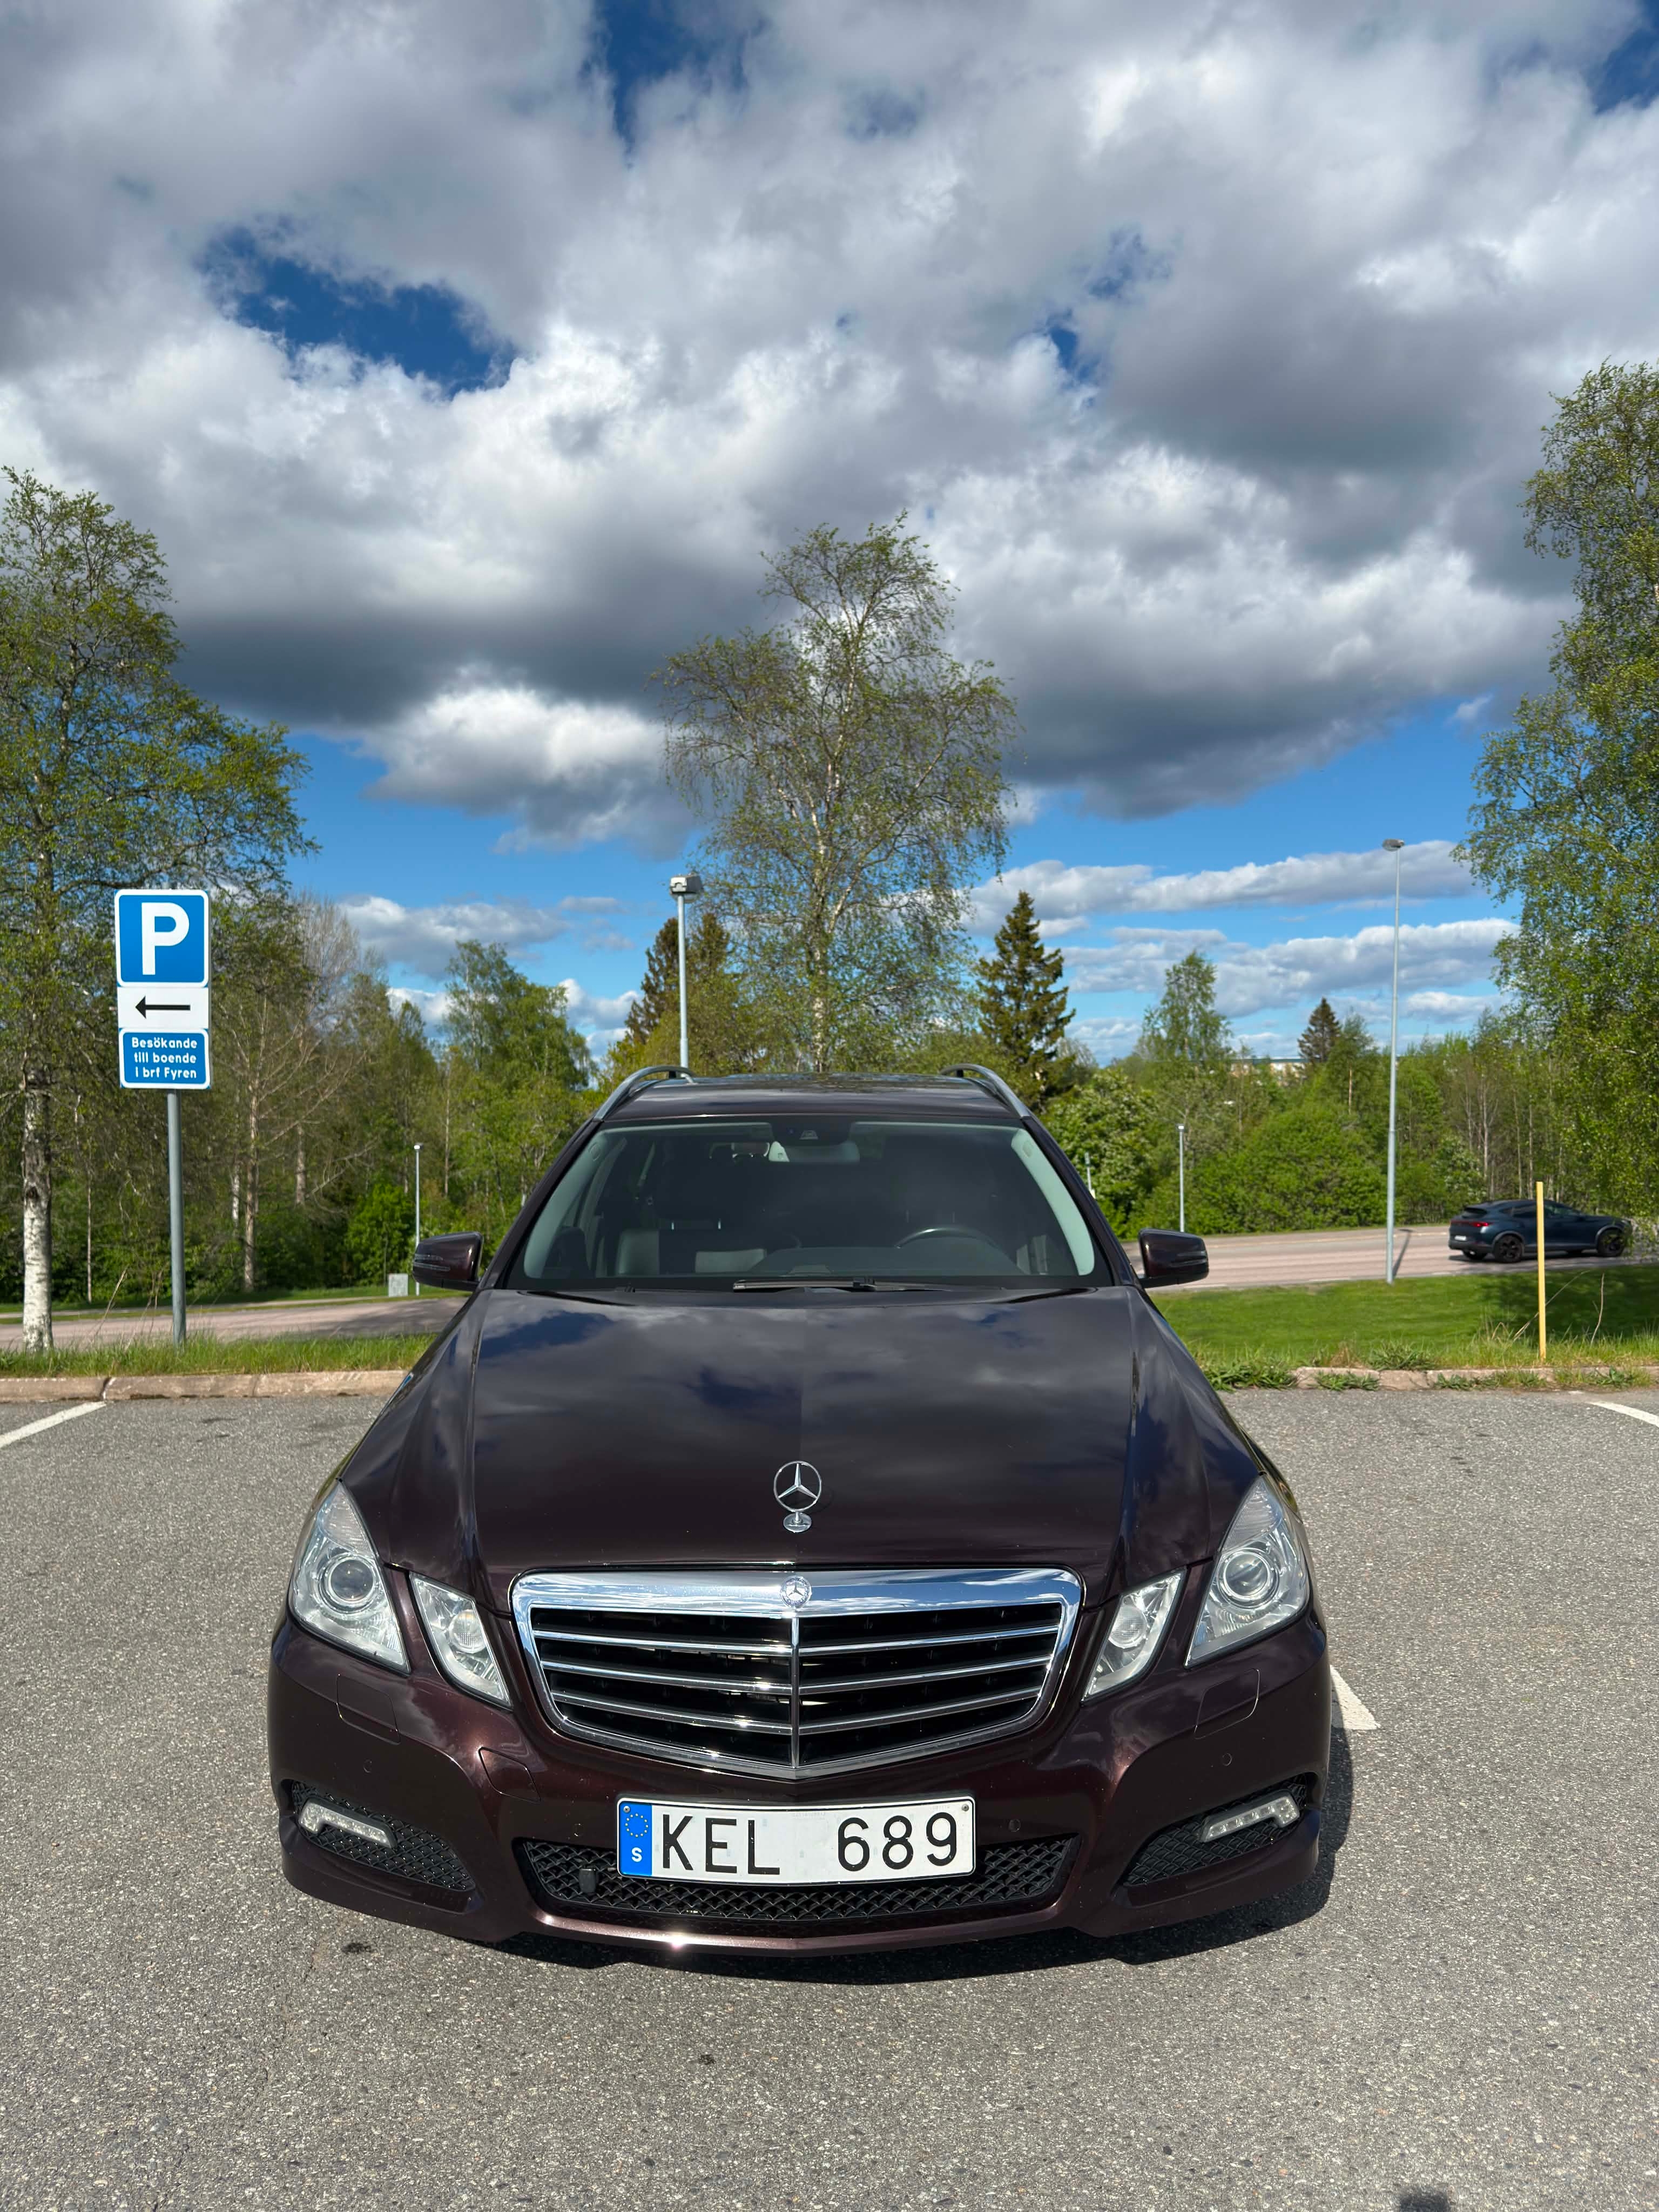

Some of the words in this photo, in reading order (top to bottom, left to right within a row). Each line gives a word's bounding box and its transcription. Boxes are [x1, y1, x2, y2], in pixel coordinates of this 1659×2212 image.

[141, 902, 190, 975] P
[132, 1037, 197, 1049] Besökande
[134, 1051, 149, 1063] till
[153, 1052, 197, 1063] boende
[143, 1067, 160, 1077] brf
[164, 1067, 197, 1081] Fyren
[663, 1814, 780, 1875] KEL
[838, 1812, 957, 1872] 689
[631, 1847, 642, 1862] S
